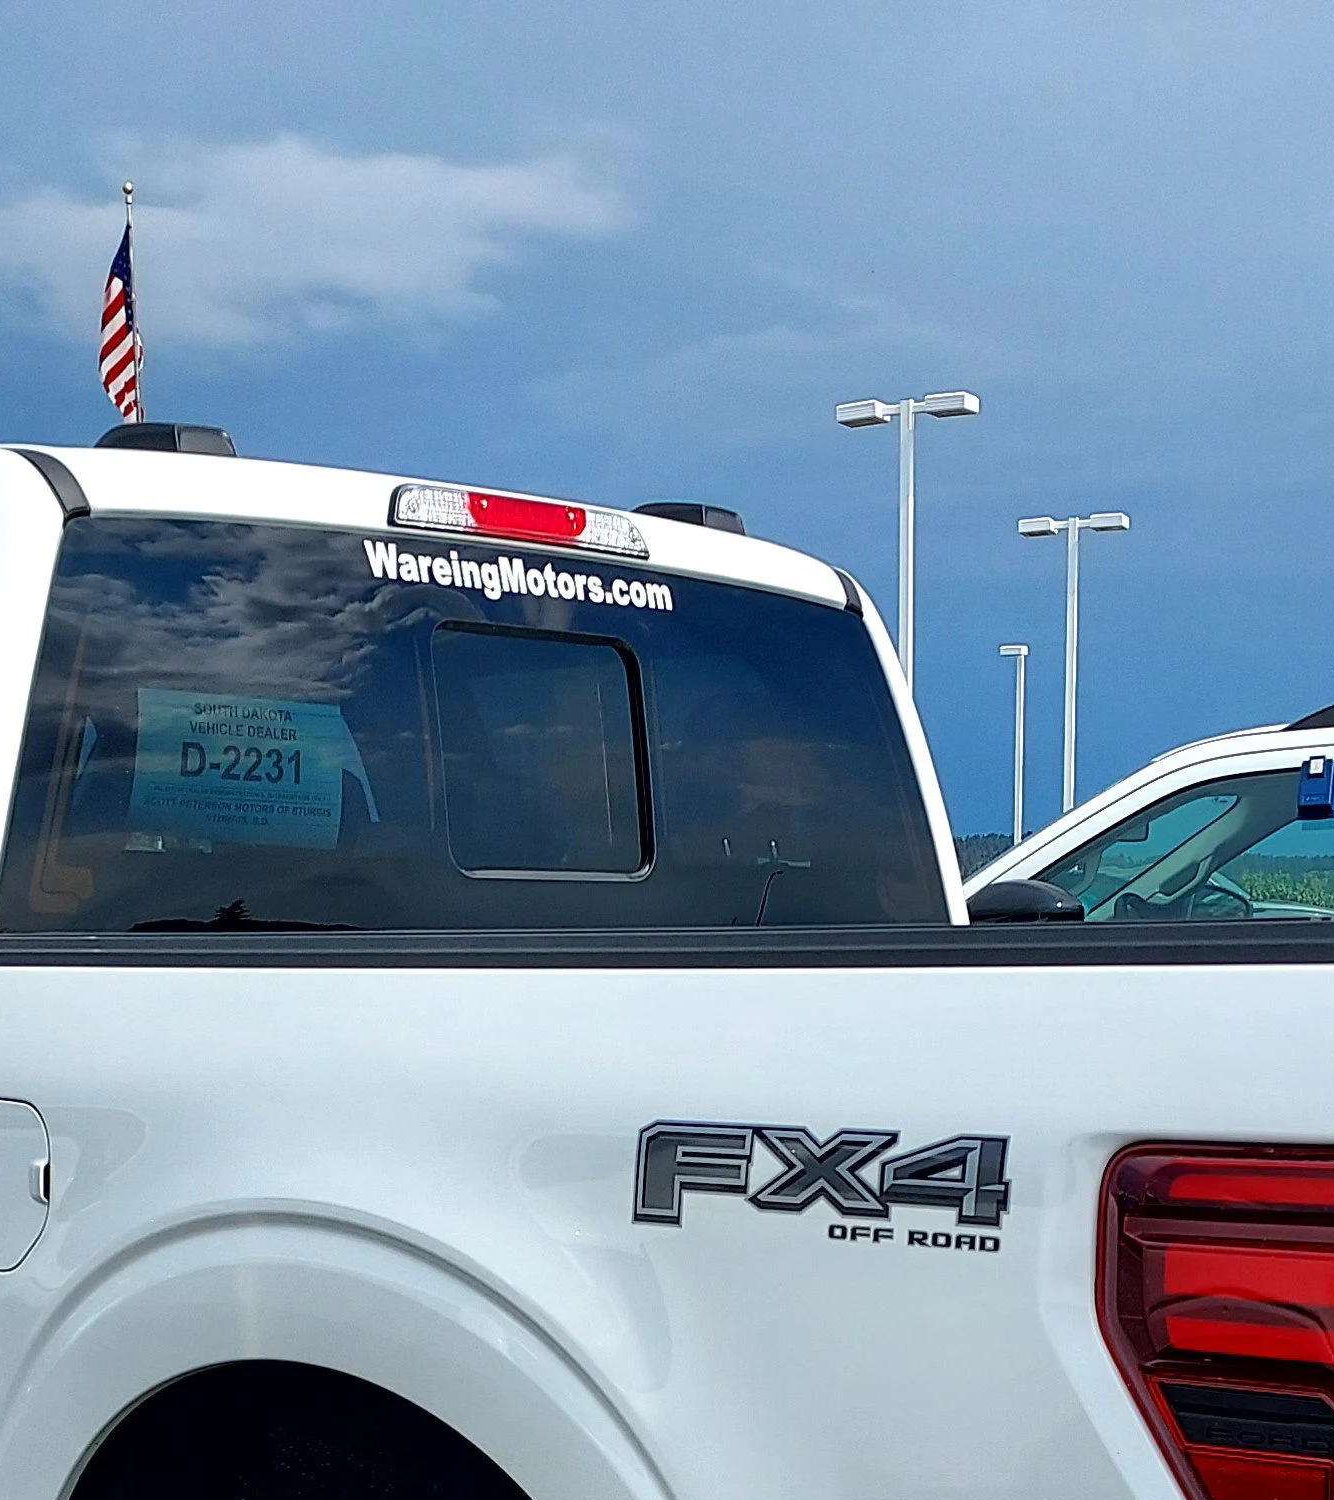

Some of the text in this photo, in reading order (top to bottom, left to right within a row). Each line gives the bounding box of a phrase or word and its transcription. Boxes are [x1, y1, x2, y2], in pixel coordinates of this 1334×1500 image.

[363, 539, 673, 611] WareingMotors.com
[194, 702, 293, 722] SOUTH DAKOTA
[189, 721, 297, 741] VEHICLE DEALER
[180, 741, 301, 784] D-2231
[234, 802, 274, 813] MOTORS
[277, 805, 289, 815] OF
[291, 806, 332, 818] STURGIS
[632, 1119, 1011, 1229] FX4
[828, 1224, 1000, 1252] OFF ROAD
[1205, 1427, 1332, 1452] FORD
